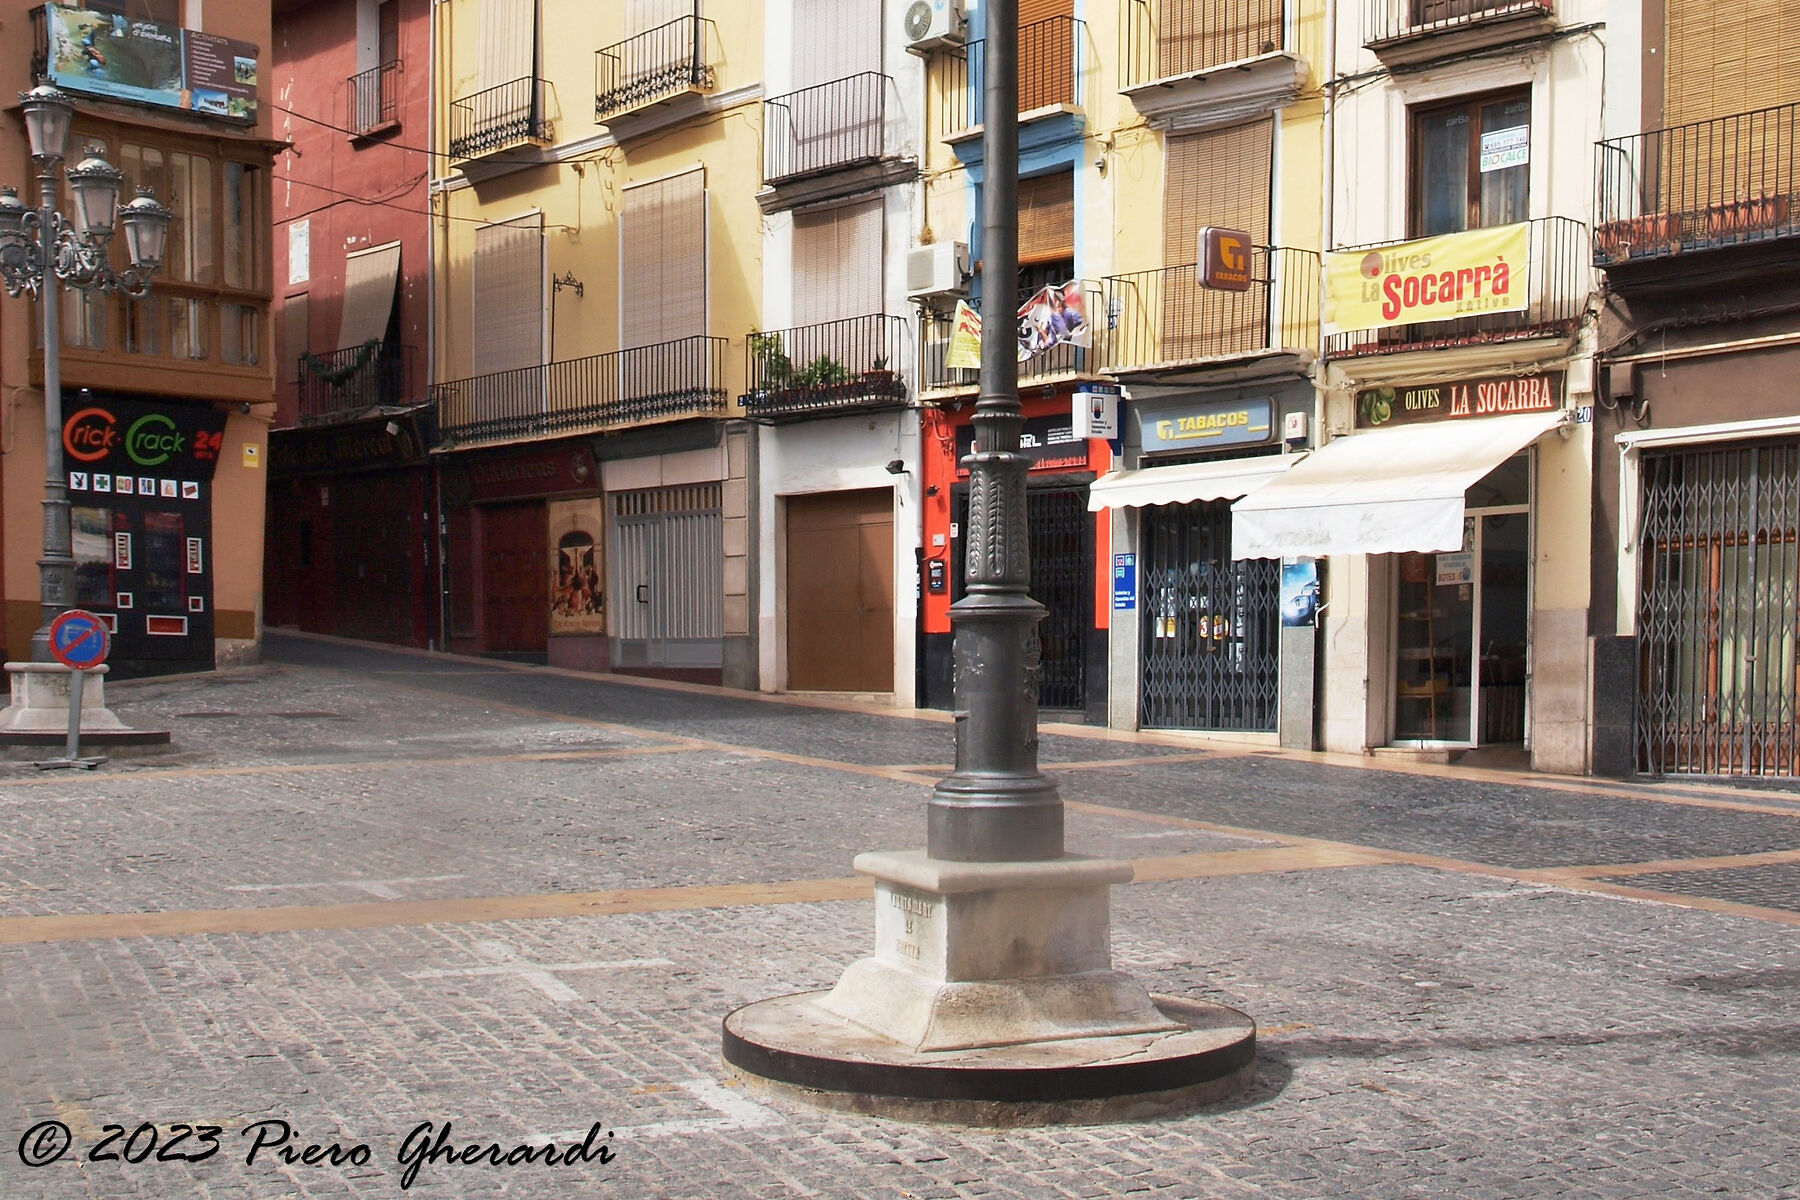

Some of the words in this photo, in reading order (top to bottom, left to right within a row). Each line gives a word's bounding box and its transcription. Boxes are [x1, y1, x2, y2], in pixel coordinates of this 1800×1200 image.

[1482, 148, 1527, 167] BIOCALCE
[1214, 271, 1248, 282] TABACOS
[1360, 251, 1432, 280] Olives
[1362, 281, 1380, 303] La
[1382, 255, 1510, 321] Socarrà
[1405, 388, 1440, 410] OLIVES
[1450, 386, 1470, 416] LA
[1476, 377, 1552, 414] SOCARRA
[1178, 410, 1249, 432] TABACOS
[1576, 406, 1591, 422] 20
[63, 407, 116, 462] Crick
[125, 413, 186, 466] Crack
[193, 431, 223, 450] 24
